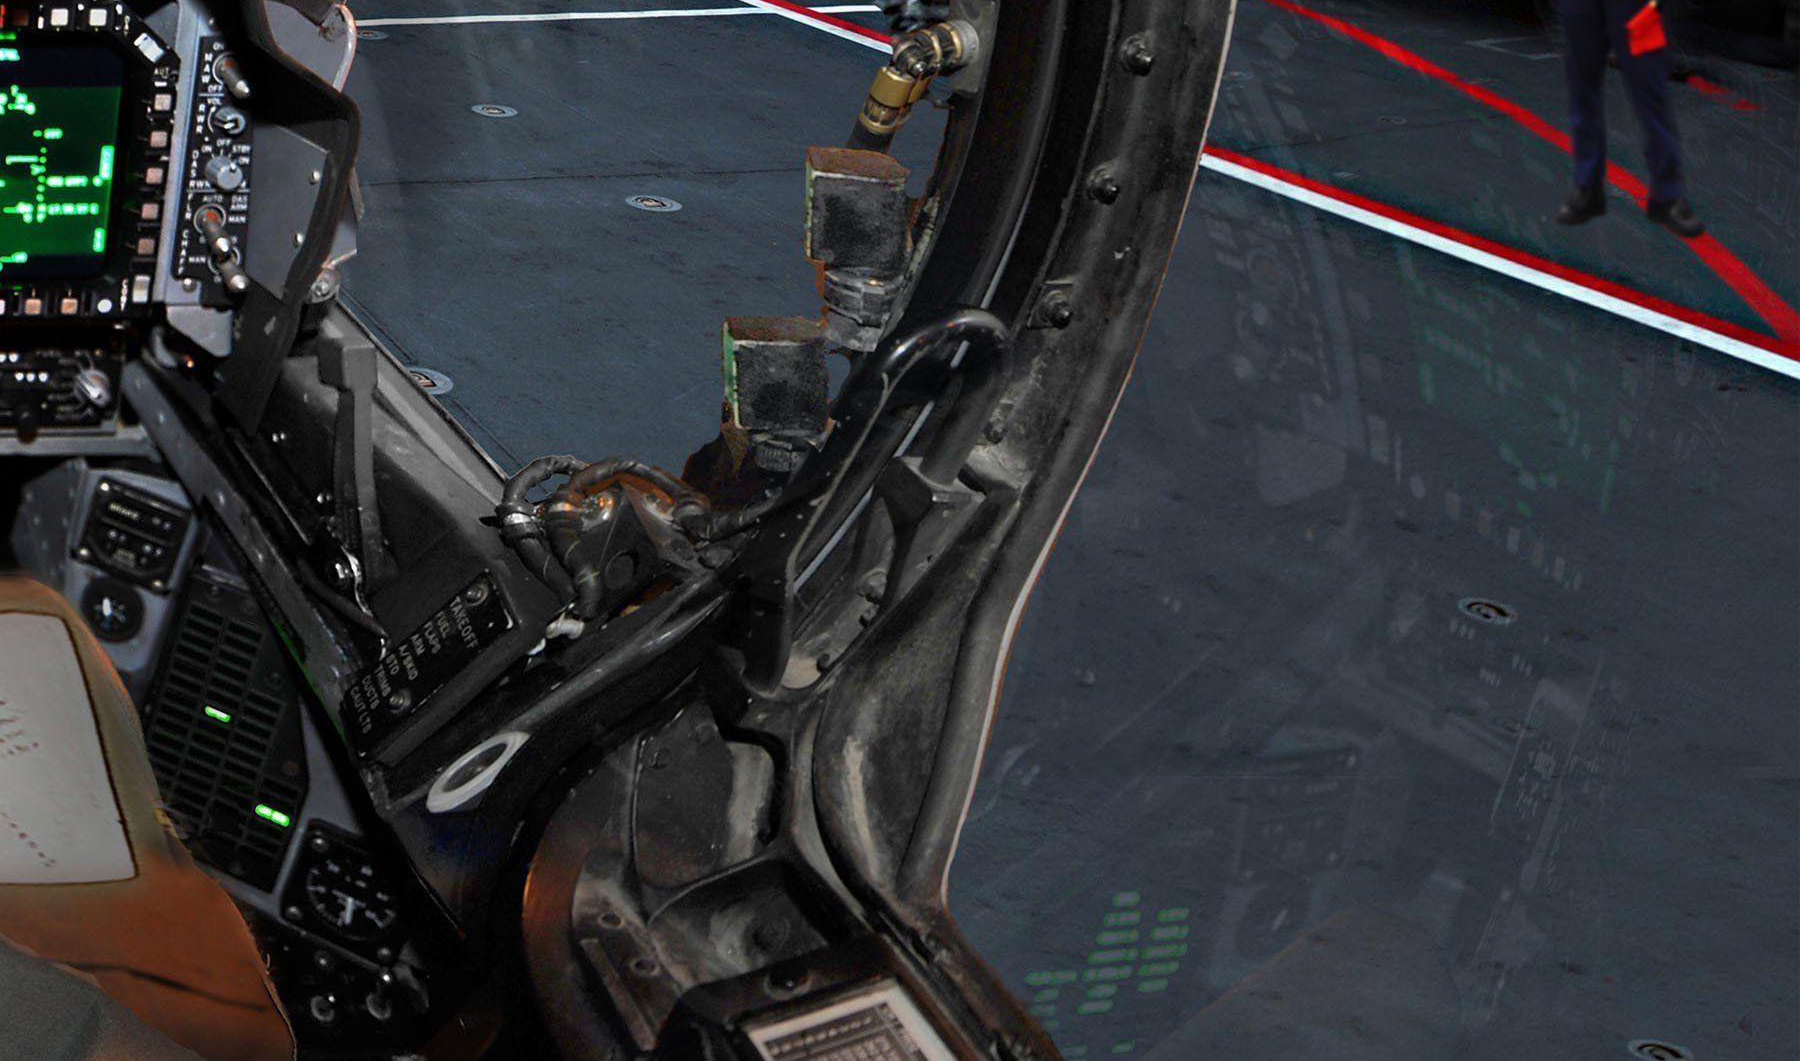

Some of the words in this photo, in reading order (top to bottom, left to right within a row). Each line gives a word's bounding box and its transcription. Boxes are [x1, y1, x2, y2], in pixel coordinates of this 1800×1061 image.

[423, 621, 442, 654] FLAPS
[435, 611, 451, 638] FUEL
[450, 596, 479, 649] TAKEOFF
[351, 686, 366, 711] CAUT
[362, 675, 380, 710] DUCTS
